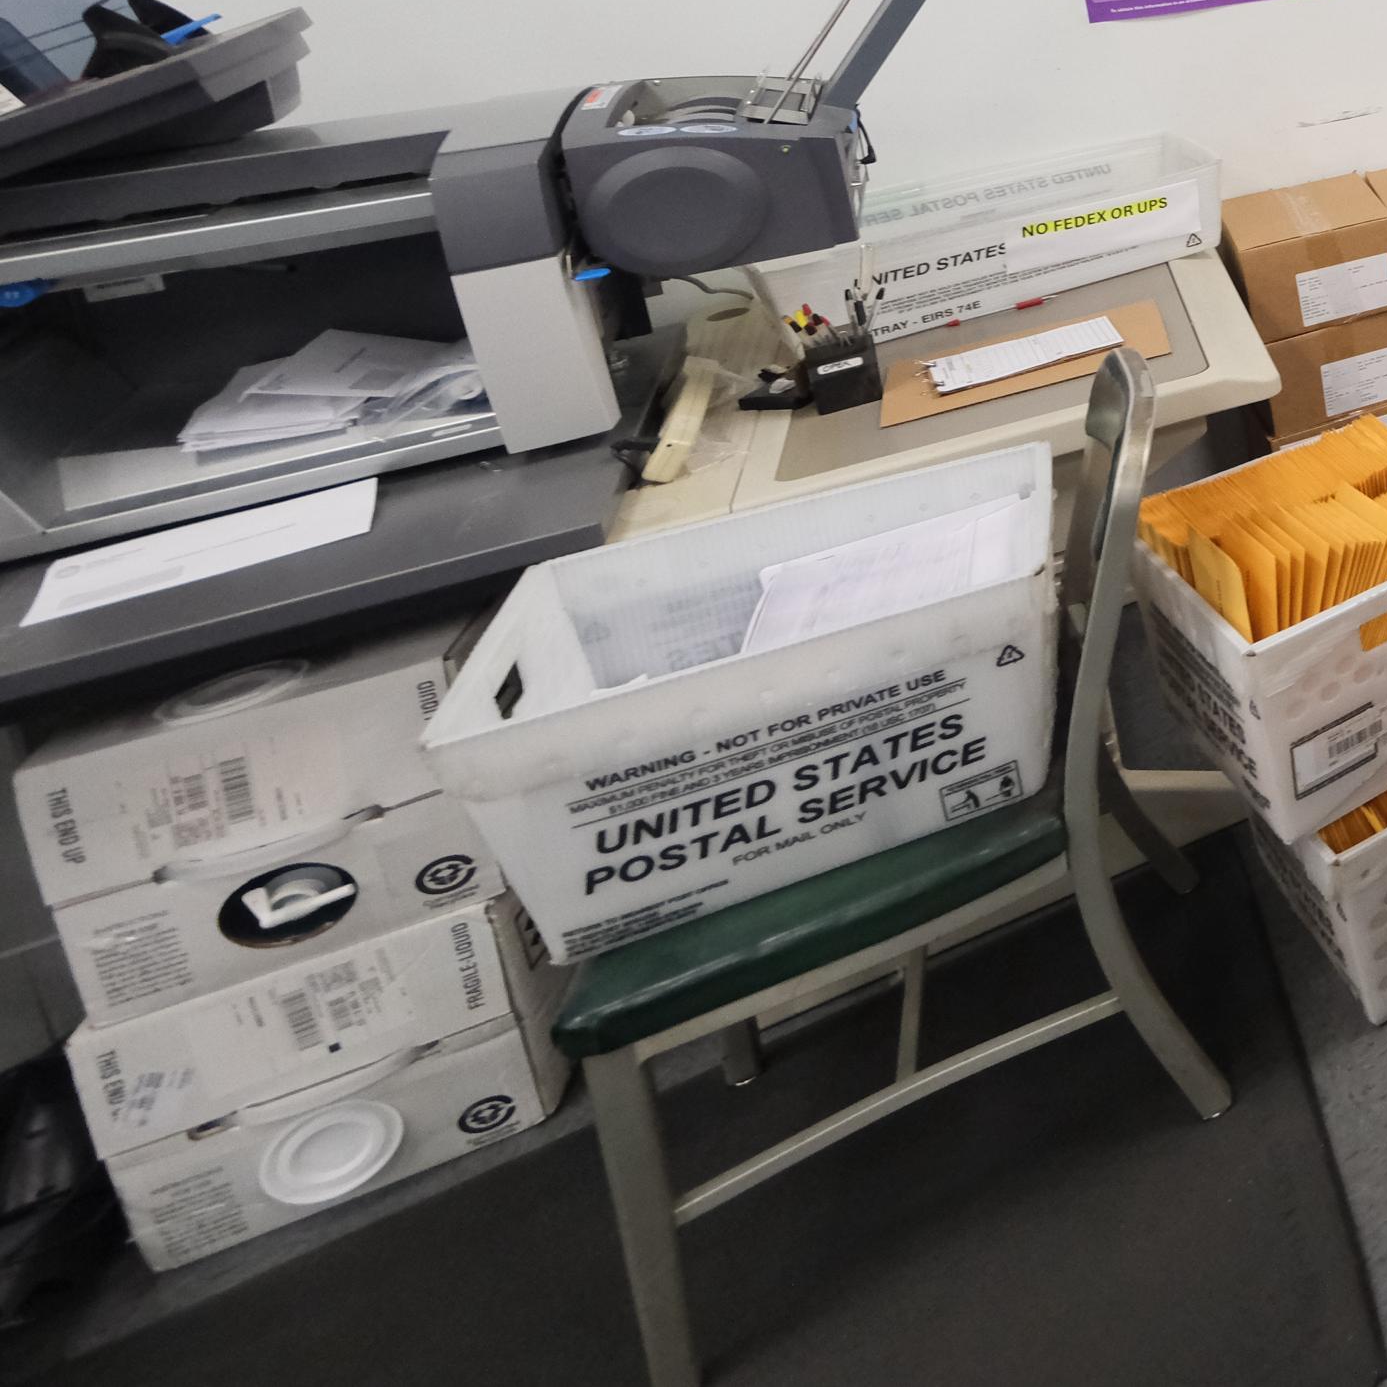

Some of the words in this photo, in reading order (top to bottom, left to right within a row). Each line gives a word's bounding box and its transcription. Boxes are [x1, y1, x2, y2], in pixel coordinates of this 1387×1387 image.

[1022, 223, 1048, 239] NO
[1053, 211, 1107, 233] FEDEX
[1110, 205, 1134, 220] OR
[1137, 197, 1168, 215] UPS
[872, 320, 909, 337] TRAY
[922, 308, 954, 324] EIRS
[957, 300, 982, 314] 74E
[584, 750, 697, 792] WARNING
[715, 729, 761, 753] NOT
[767, 714, 812, 737] FOR
[817, 685, 901, 722] PRIVATE
[905, 669, 947, 692] USE
[637, 771, 695, 795] PENALTY
[697, 762, 727, 775] FOR
[770, 740, 791, 753] OR
[838, 718, 857, 730] OF
[858, 704, 903, 723] POSTAL
[903, 681, 967, 709] PROPERTY
[46, 787, 75, 818] THIS
[595, 779, 777, 854] UNITED
[793, 713, 965, 792] STATES
[683, 776, 712, 792] AND
[54, 819, 81, 847] END
[584, 814, 783, 896] POSTAL
[797, 735, 987, 824] SERVICE
[63, 847, 86, 865] UP
[732, 845, 772, 867] FOR
[774, 827, 818, 855] MAIL
[820, 812, 866, 838] ONLY
[448, 921, 487, 1012] FRAGILE-LIQUID
[97, 1050, 123, 1080] THIS
